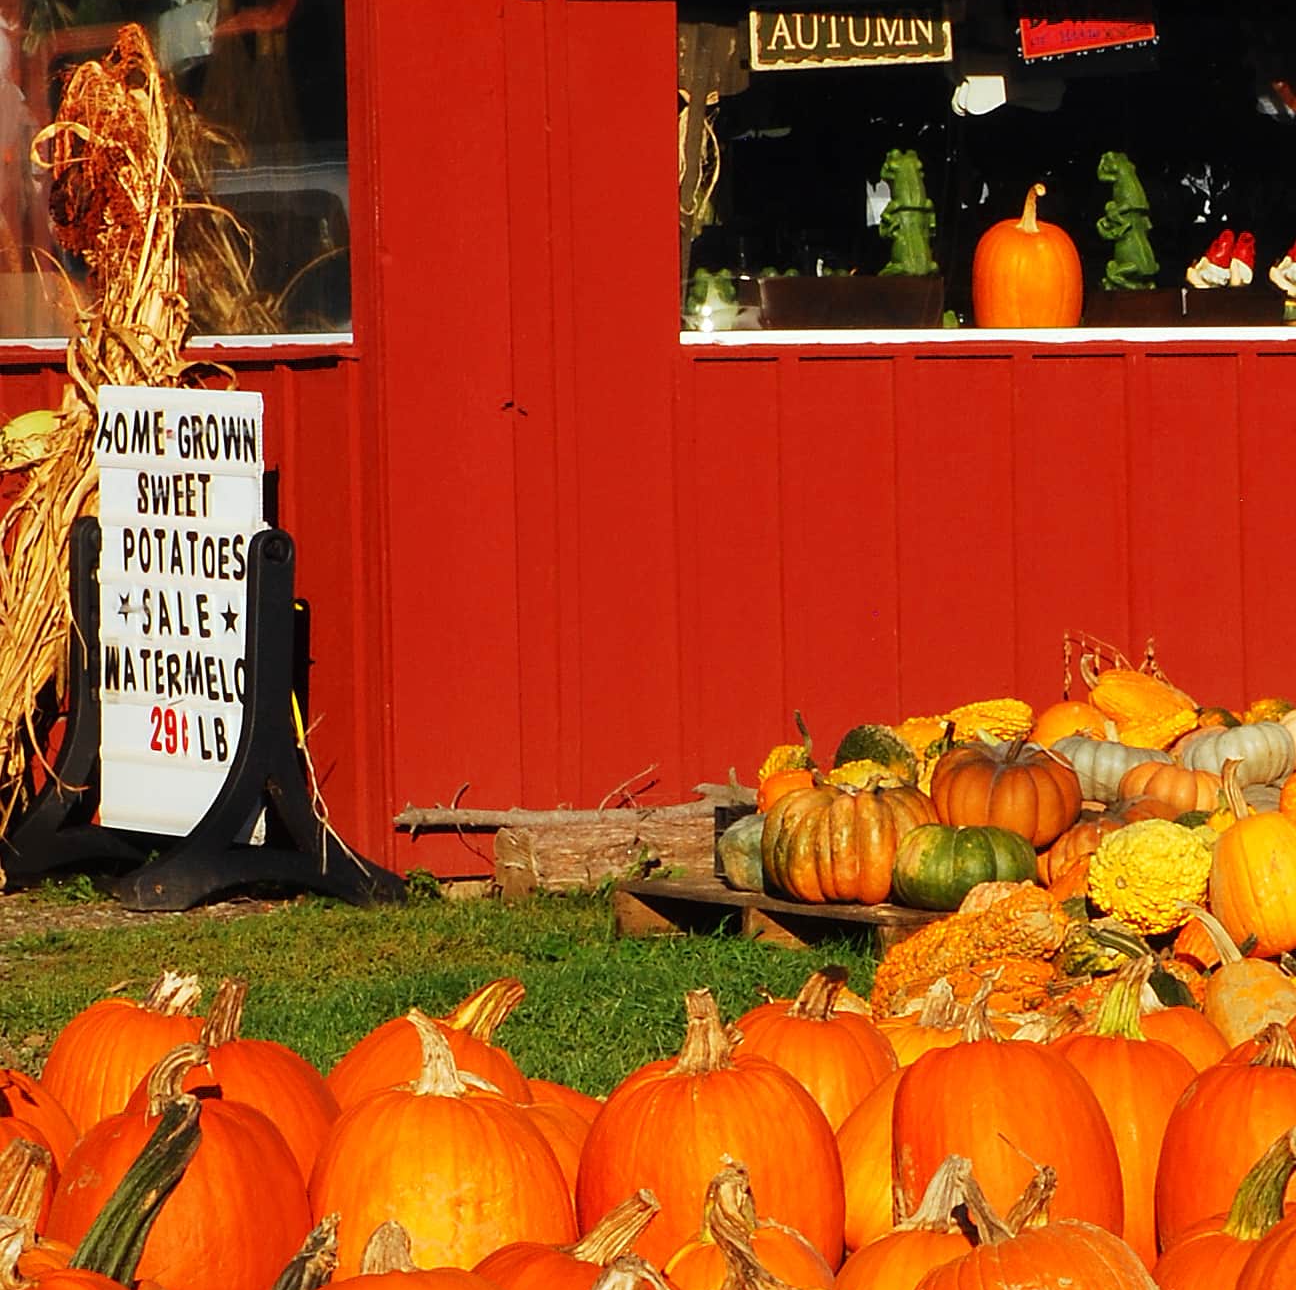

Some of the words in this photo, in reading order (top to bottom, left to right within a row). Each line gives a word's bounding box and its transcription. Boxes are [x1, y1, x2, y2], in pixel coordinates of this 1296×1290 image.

[766, 13, 933, 50] AUTUMN
[137, 471, 211, 517] SWEET
[123, 527, 246, 581] POTATOES
[142, 588, 211, 638] SALE
[198, 715, 228, 762] LB
